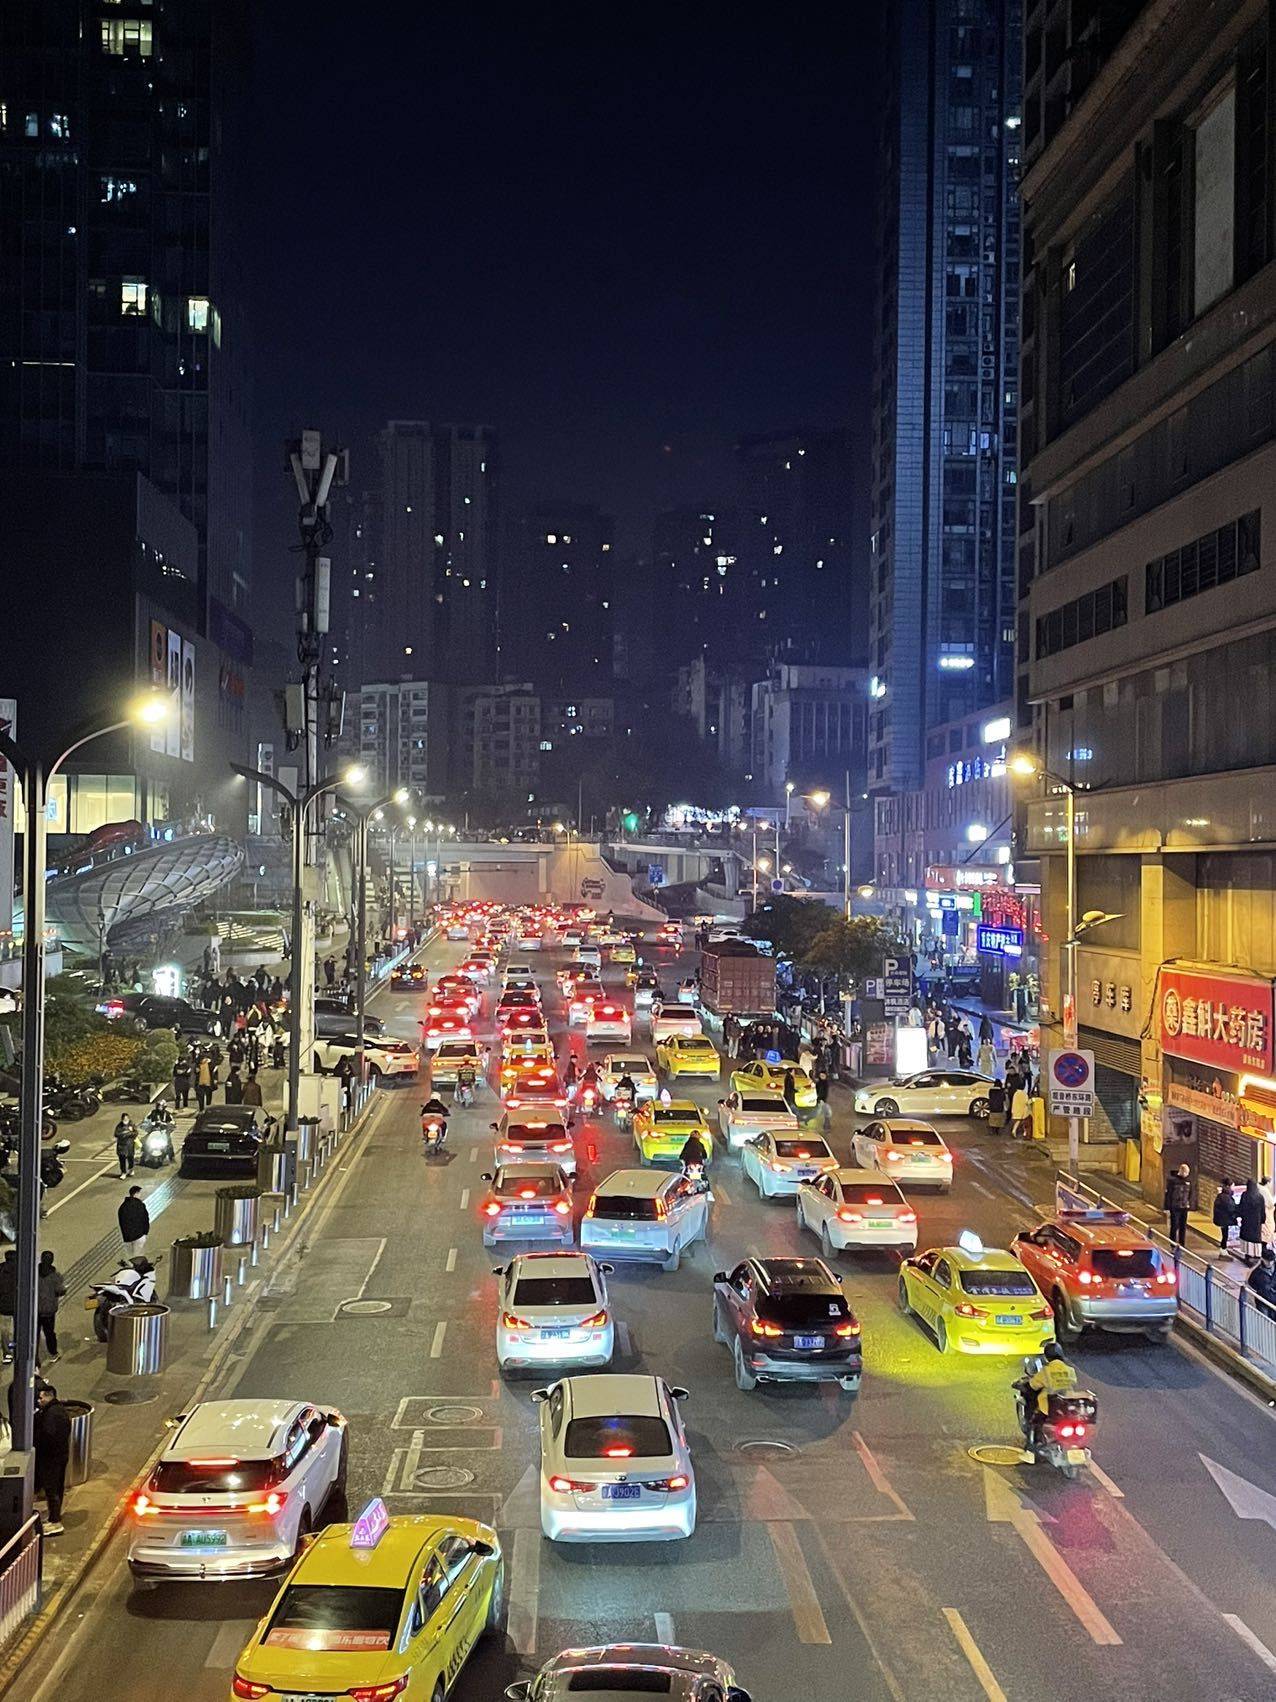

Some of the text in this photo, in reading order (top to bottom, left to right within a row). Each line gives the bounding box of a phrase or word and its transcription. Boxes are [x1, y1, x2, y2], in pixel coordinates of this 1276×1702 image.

[885, 959, 899, 977] P
[866, 979, 875, 993] P
[885, 978, 910, 988] 停车场
[1053, 1105, 1092, 1116] 严管路段
